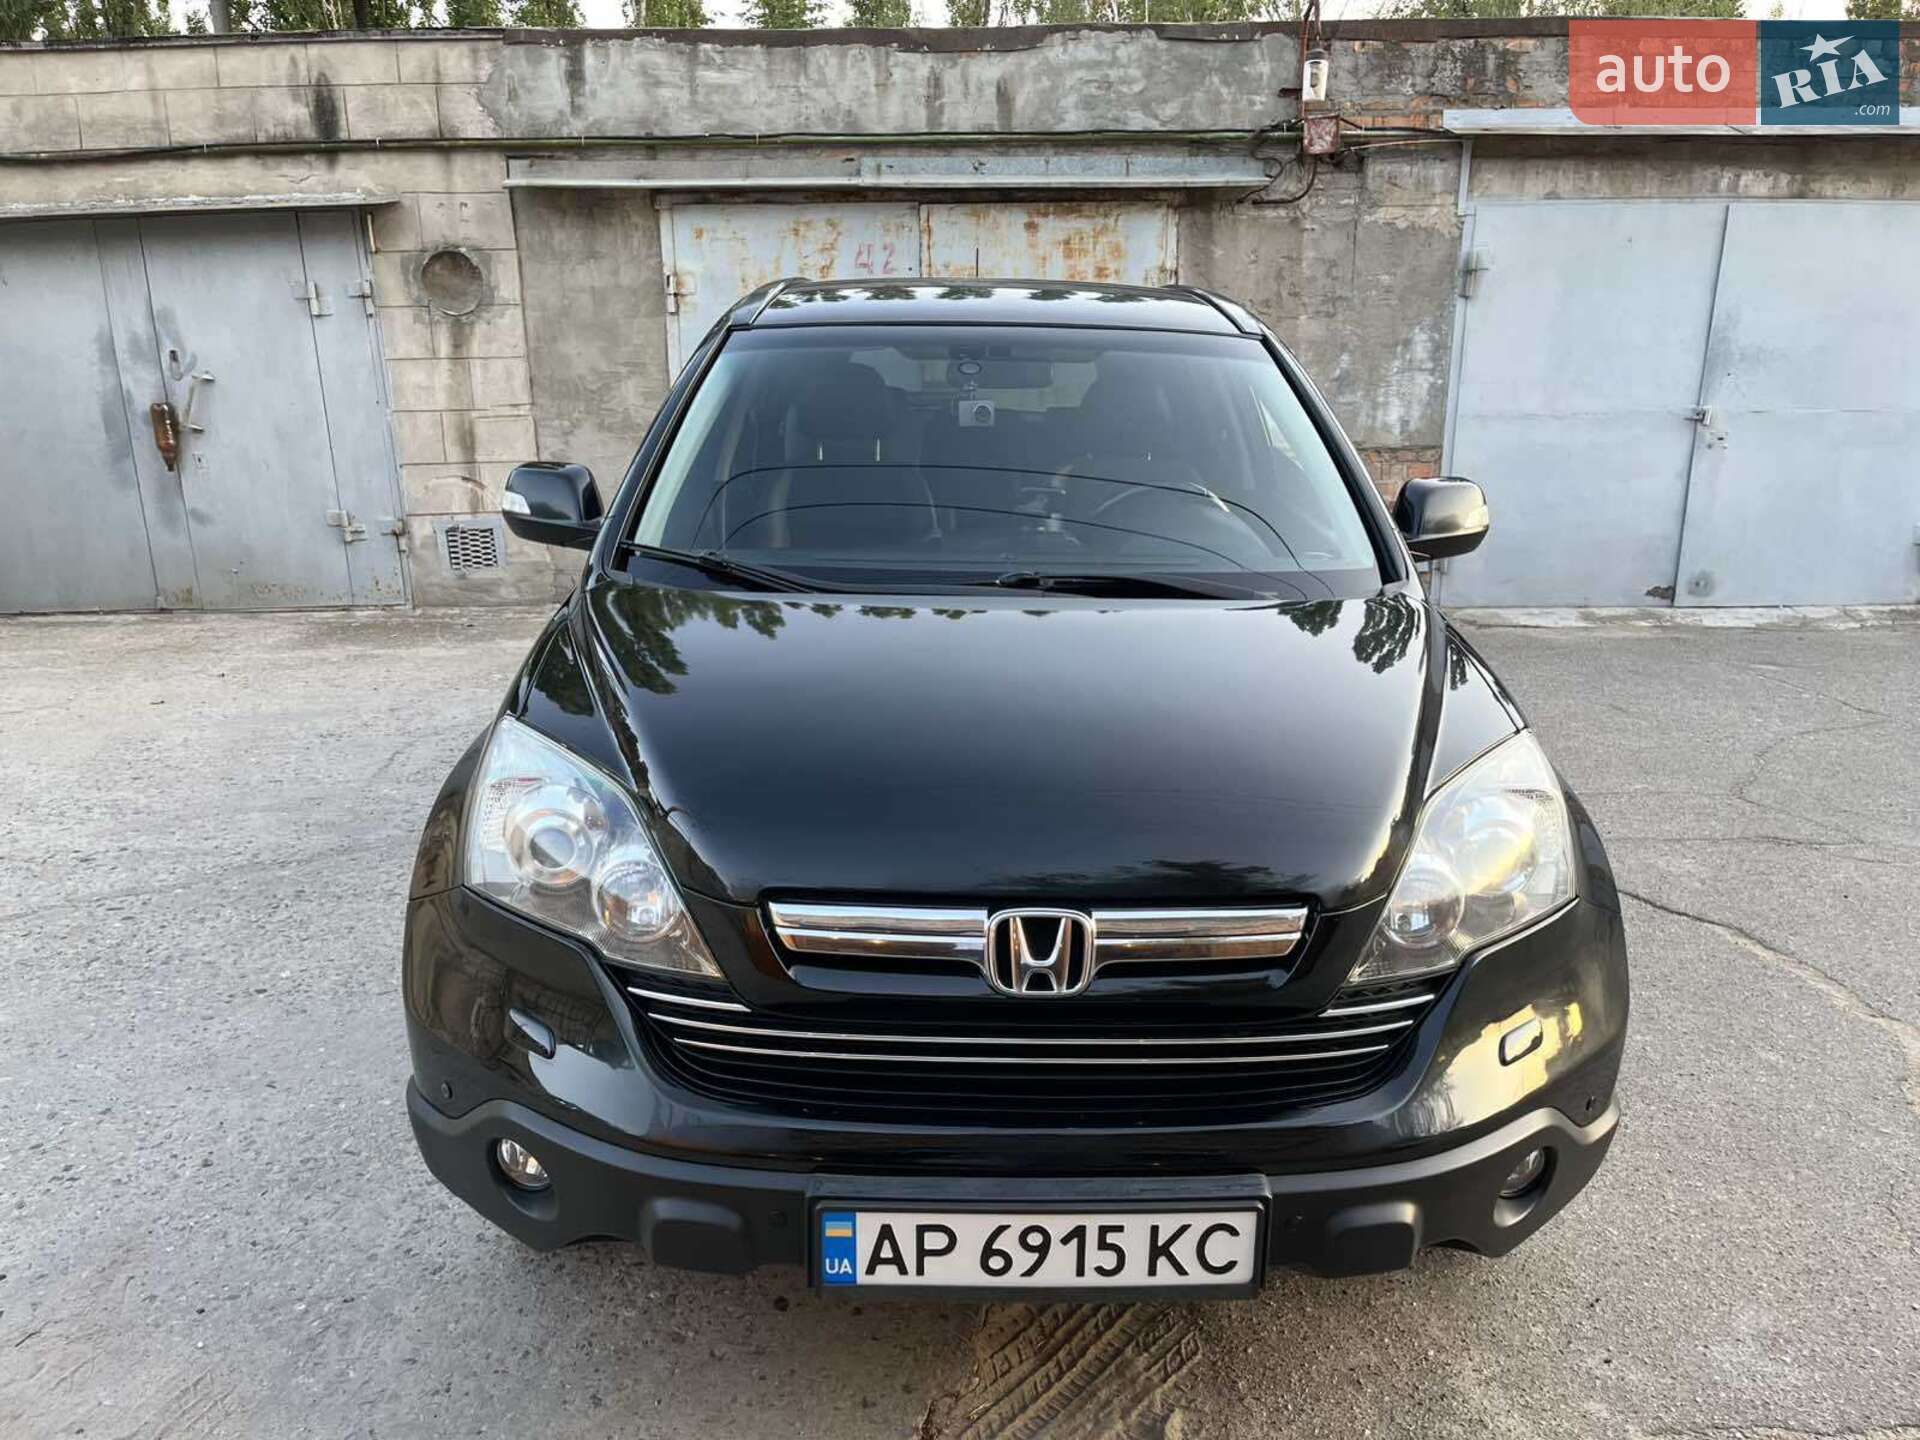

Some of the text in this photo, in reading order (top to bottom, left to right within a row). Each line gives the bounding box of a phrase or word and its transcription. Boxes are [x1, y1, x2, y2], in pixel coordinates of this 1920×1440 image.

[825, 1258, 852, 1275] UA
[865, 1222, 1241, 1278] AP 6915 KC
